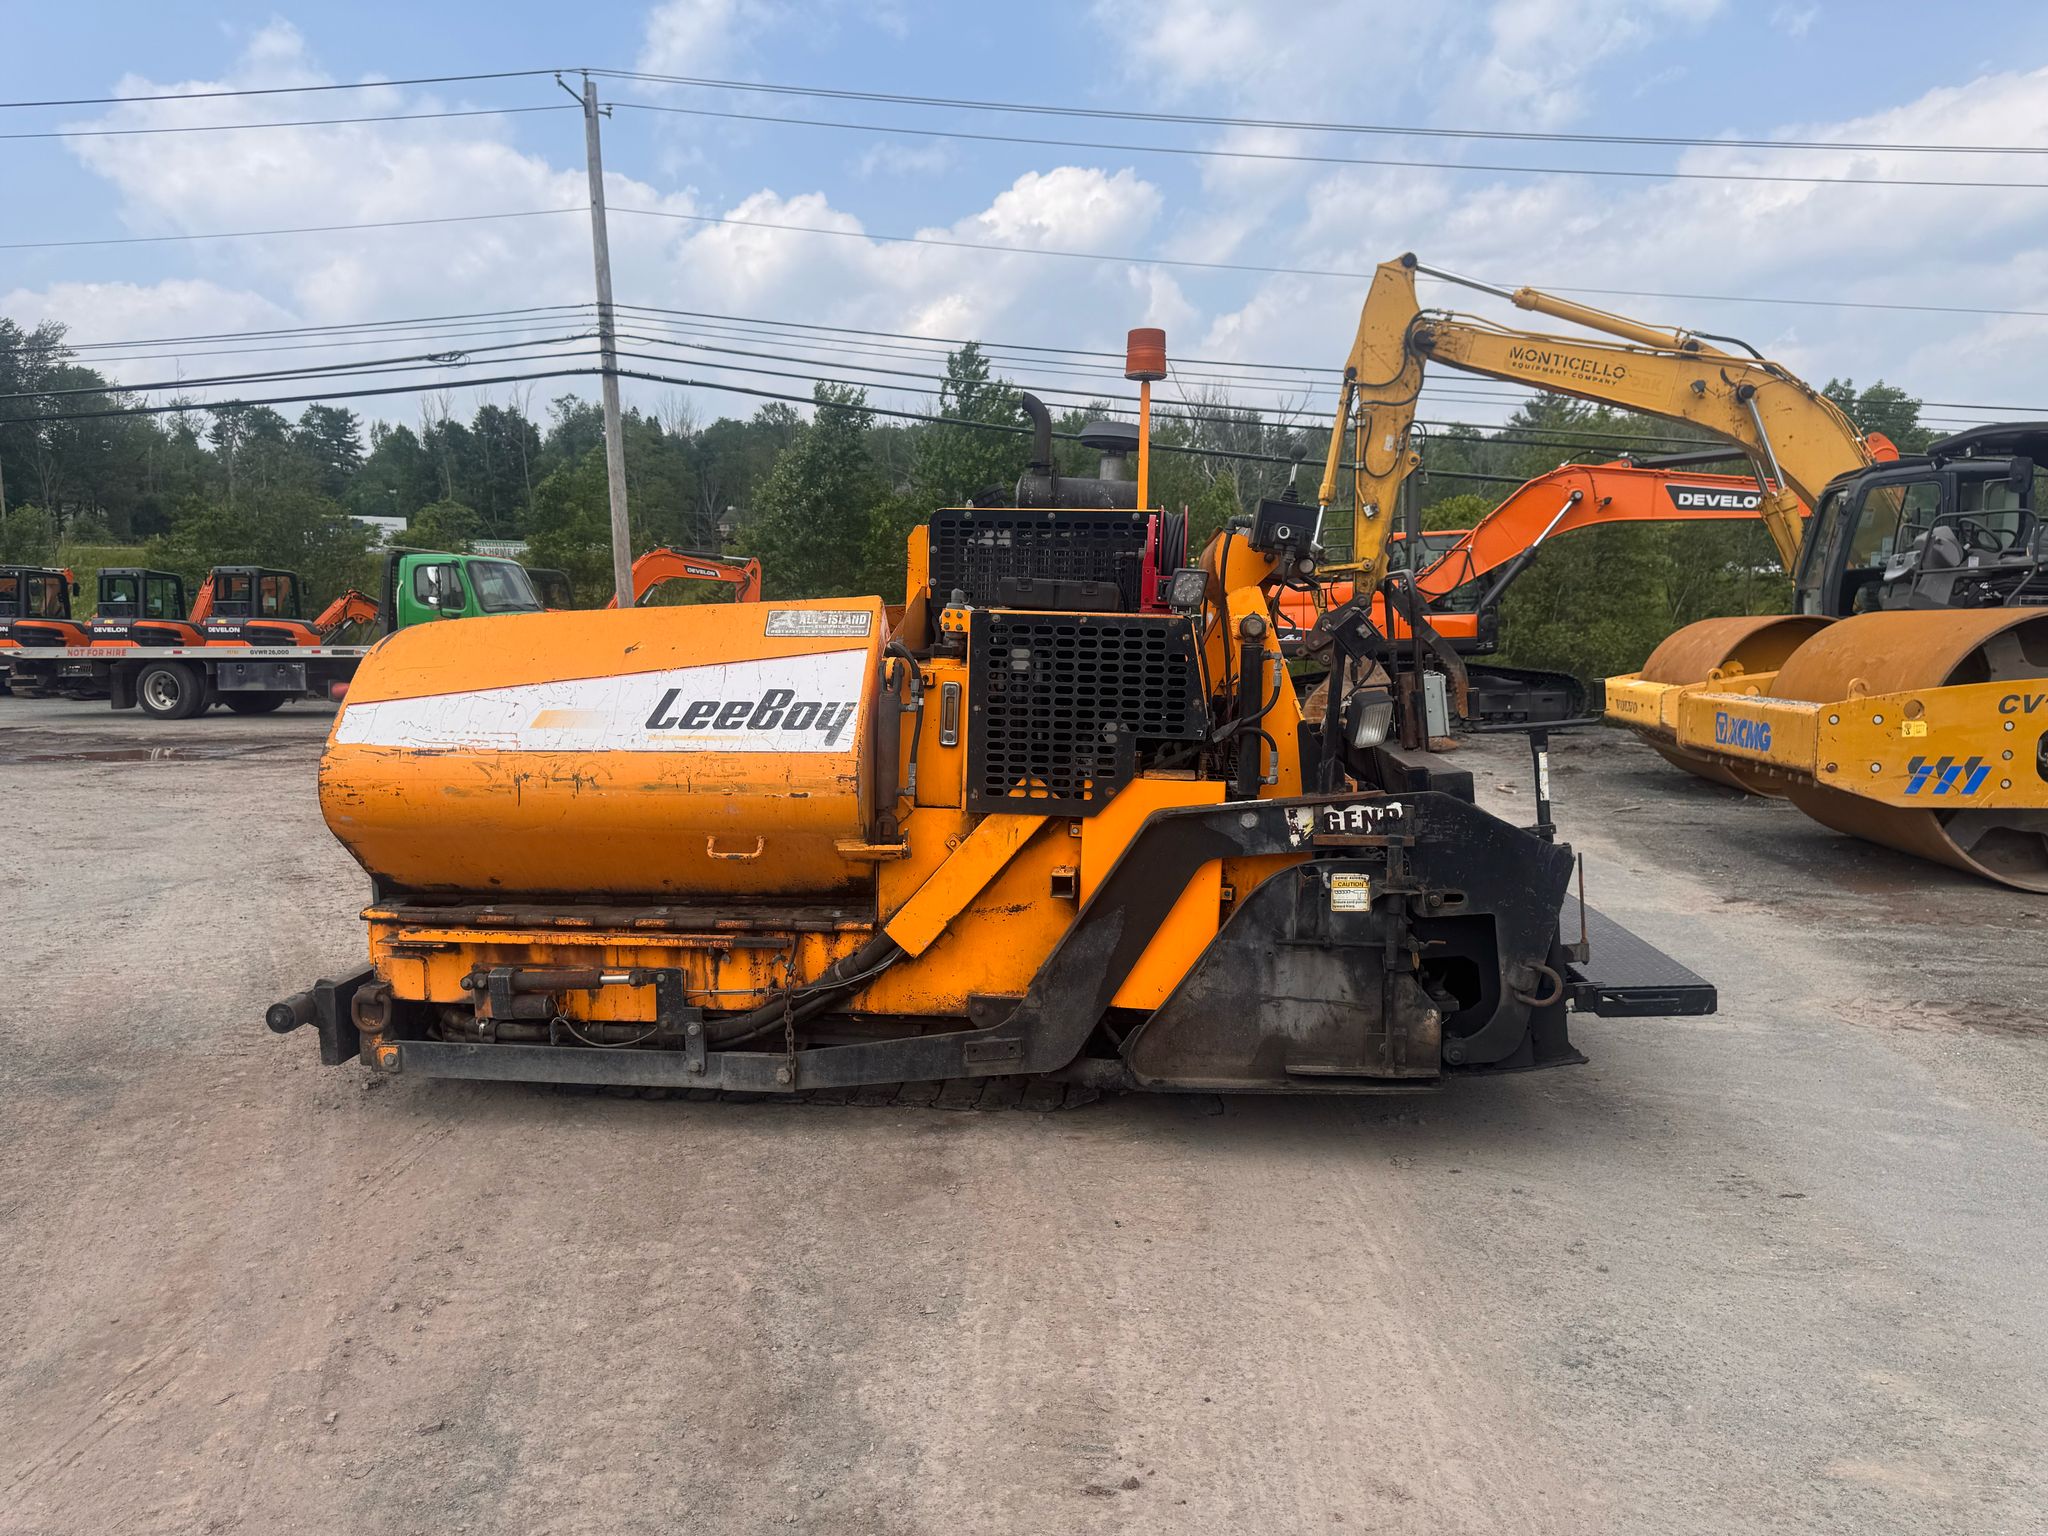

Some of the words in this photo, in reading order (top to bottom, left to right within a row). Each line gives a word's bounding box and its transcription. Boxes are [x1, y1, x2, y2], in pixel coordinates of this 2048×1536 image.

[1509, 346, 1626, 379] MONTICELLO
[1512, 362, 1567, 377] EQUIPMENT
[1571, 372, 1618, 386] COMPANY
[687, 567, 716, 576] DEVELON
[1615, 698, 1638, 714] VOLVO
[1998, 694, 2048, 714] CV
[645, 688, 858, 746] LeeBoy
[1728, 716, 1772, 752] XCMG
